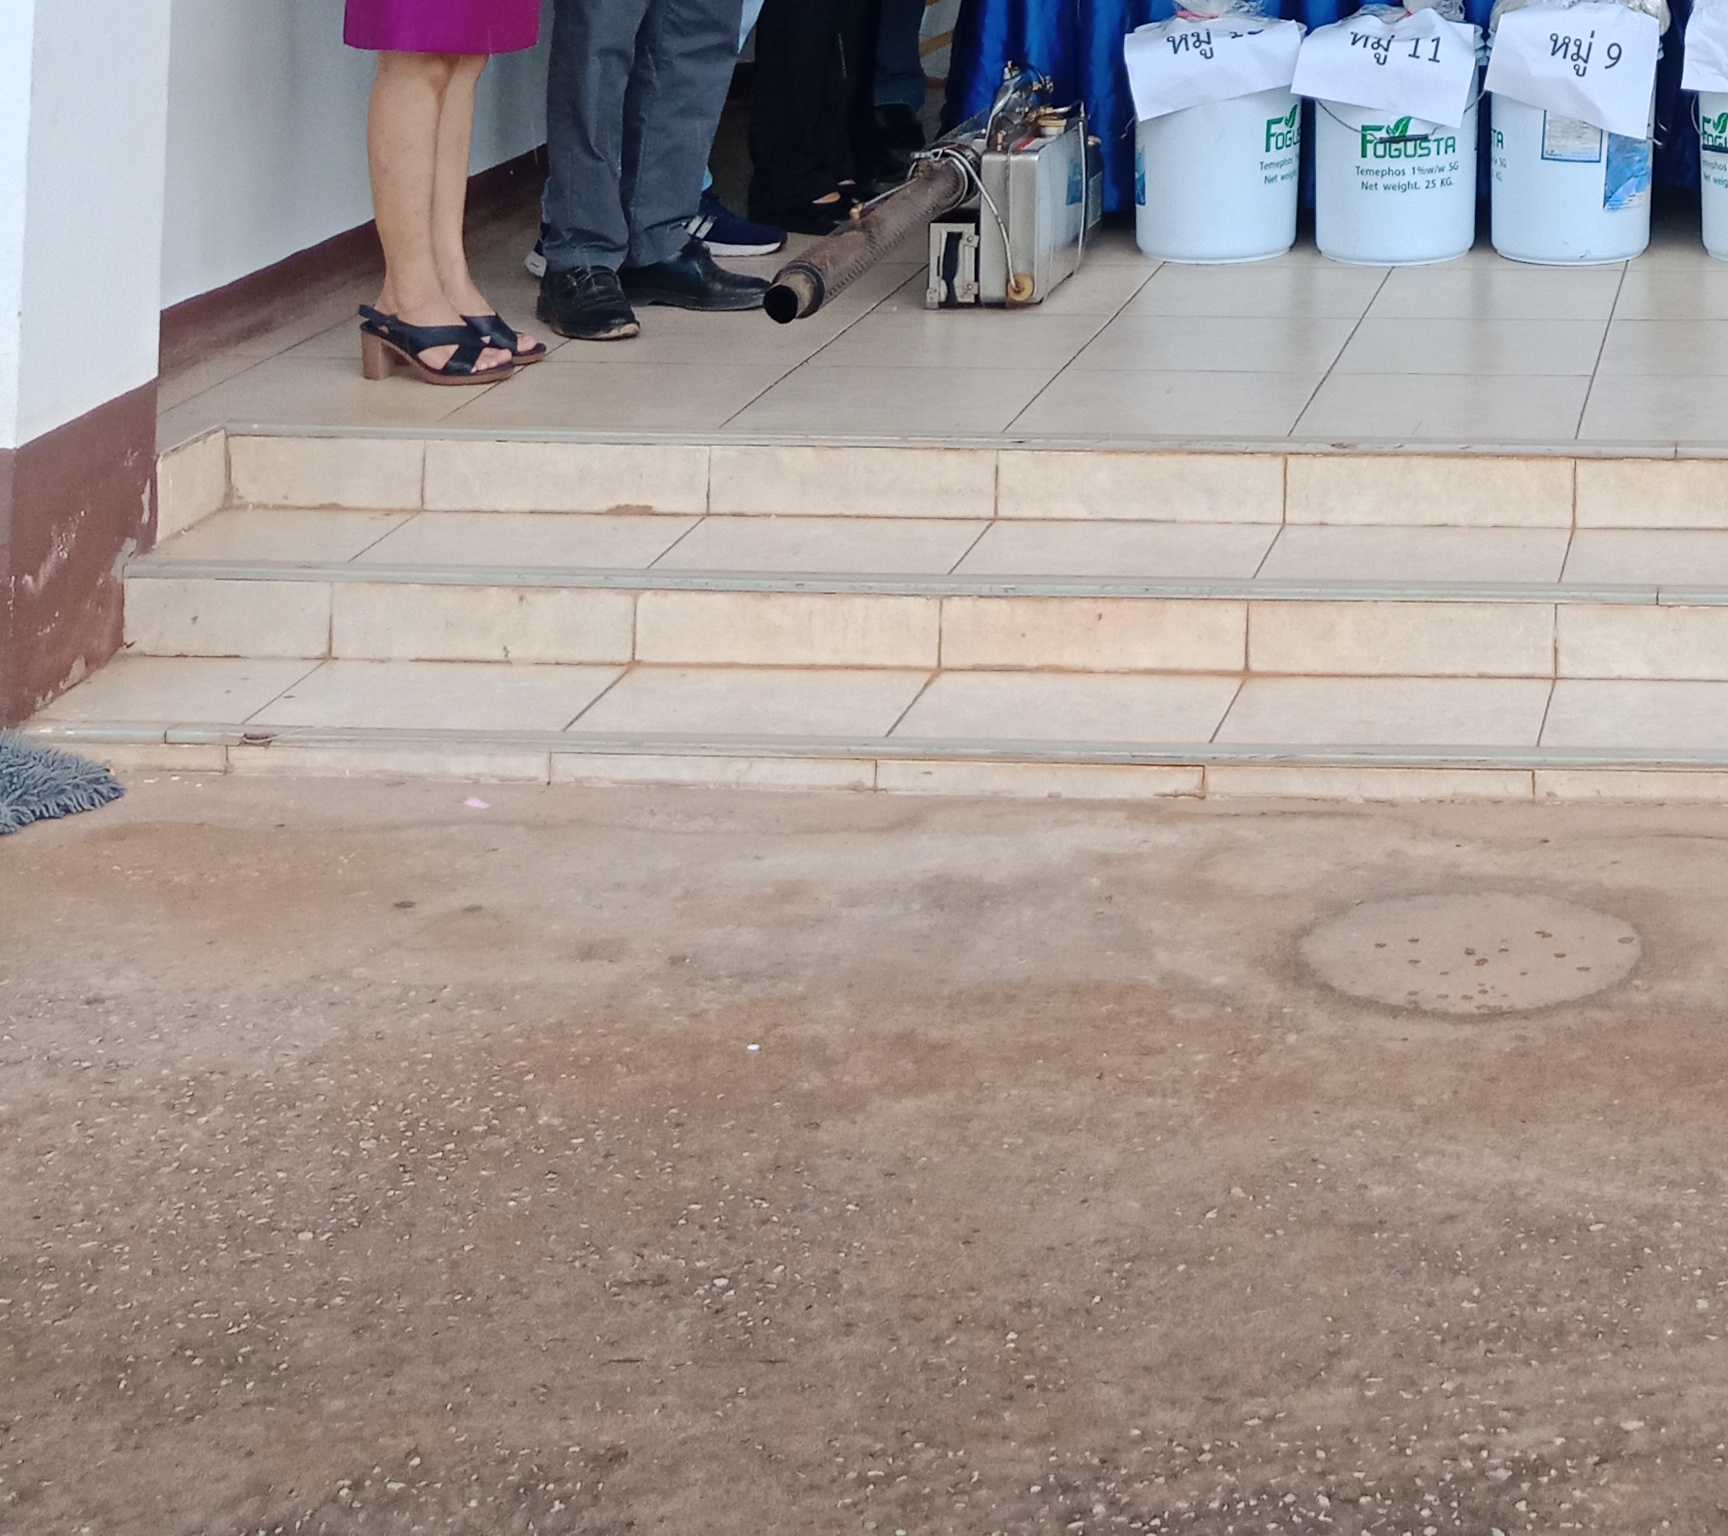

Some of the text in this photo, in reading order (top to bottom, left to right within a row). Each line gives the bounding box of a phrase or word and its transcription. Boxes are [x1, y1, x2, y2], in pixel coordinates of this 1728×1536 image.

[1408, 36, 1441, 63] 11
[1549, 30, 1623, 77] หมู่ 9
[1355, 166, 1406, 178] Temephos
[1449, 161, 1459, 172] SG
[1361, 181, 1378, 190] Net
[1425, 179, 1436, 189] 25
